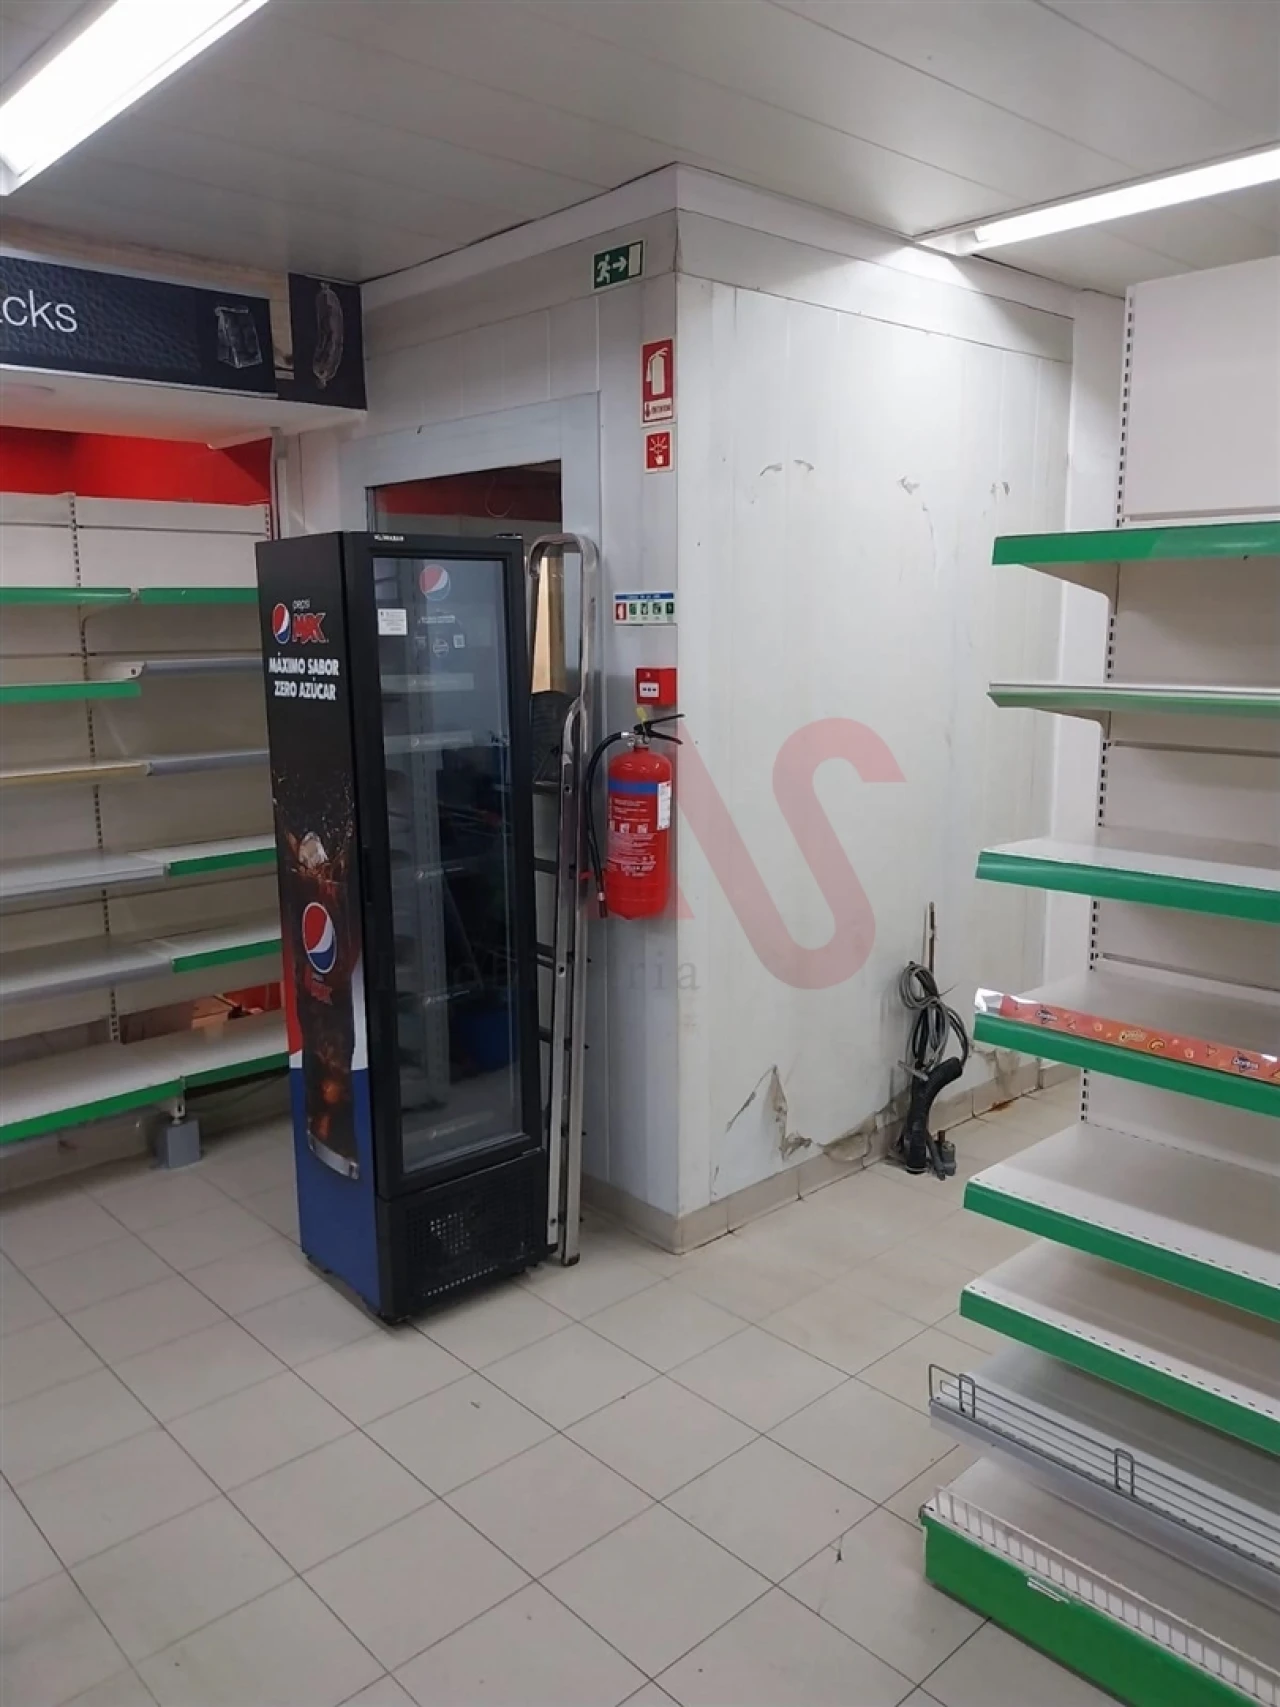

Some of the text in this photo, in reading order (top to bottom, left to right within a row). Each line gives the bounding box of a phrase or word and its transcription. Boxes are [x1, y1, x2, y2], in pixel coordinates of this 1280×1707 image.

[0, 289, 78, 333] cks
[268, 651, 340, 676] MÁXIMO SABOR
[274, 676, 337, 700] ZERO AZÚCAR
